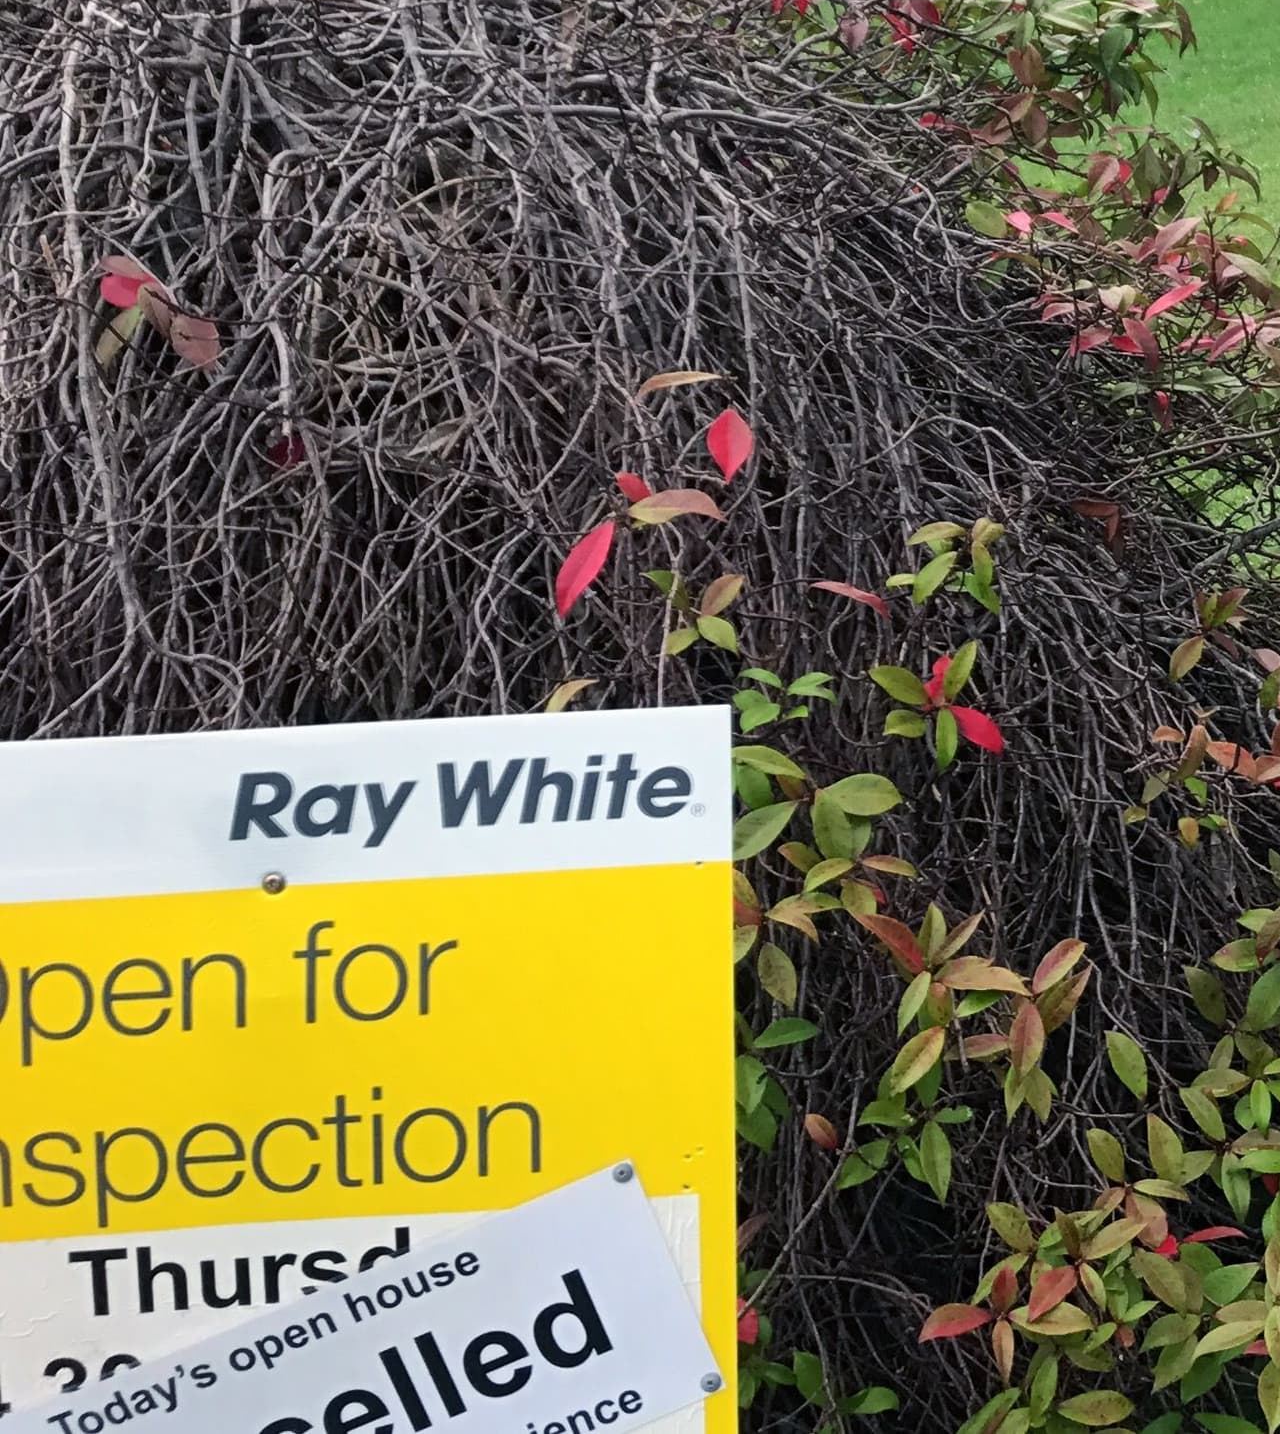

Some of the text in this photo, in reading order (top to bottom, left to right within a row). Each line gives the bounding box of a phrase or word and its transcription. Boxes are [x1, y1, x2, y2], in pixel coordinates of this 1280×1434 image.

[228, 771, 418, 849] Ray
[0, 921, 459, 1067] pen for
[0, 1086, 542, 1228] spection
[229, 1312, 338, 1372] open
[343, 1251, 480, 1323] house
